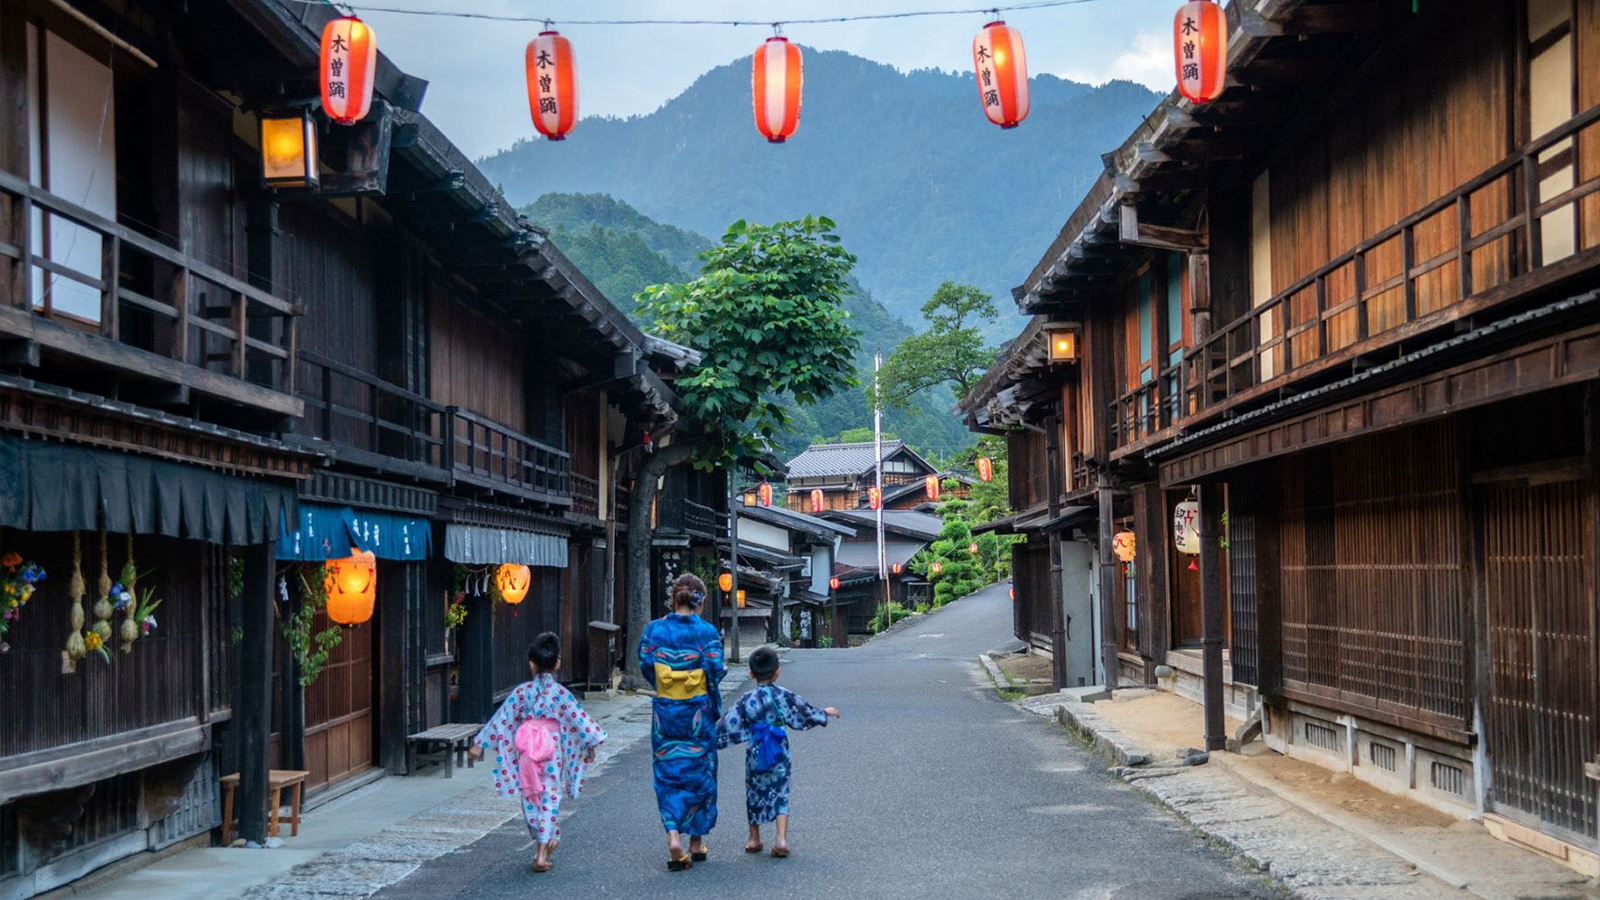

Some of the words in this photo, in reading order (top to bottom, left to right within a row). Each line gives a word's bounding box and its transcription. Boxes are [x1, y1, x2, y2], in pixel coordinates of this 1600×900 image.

[328, 34, 348, 98] 木曽踊
[977, 45, 999, 107] 木曽踊
[1181, 17, 1200, 80] 木曽踊
[536, 50, 557, 114] 木曽踊
